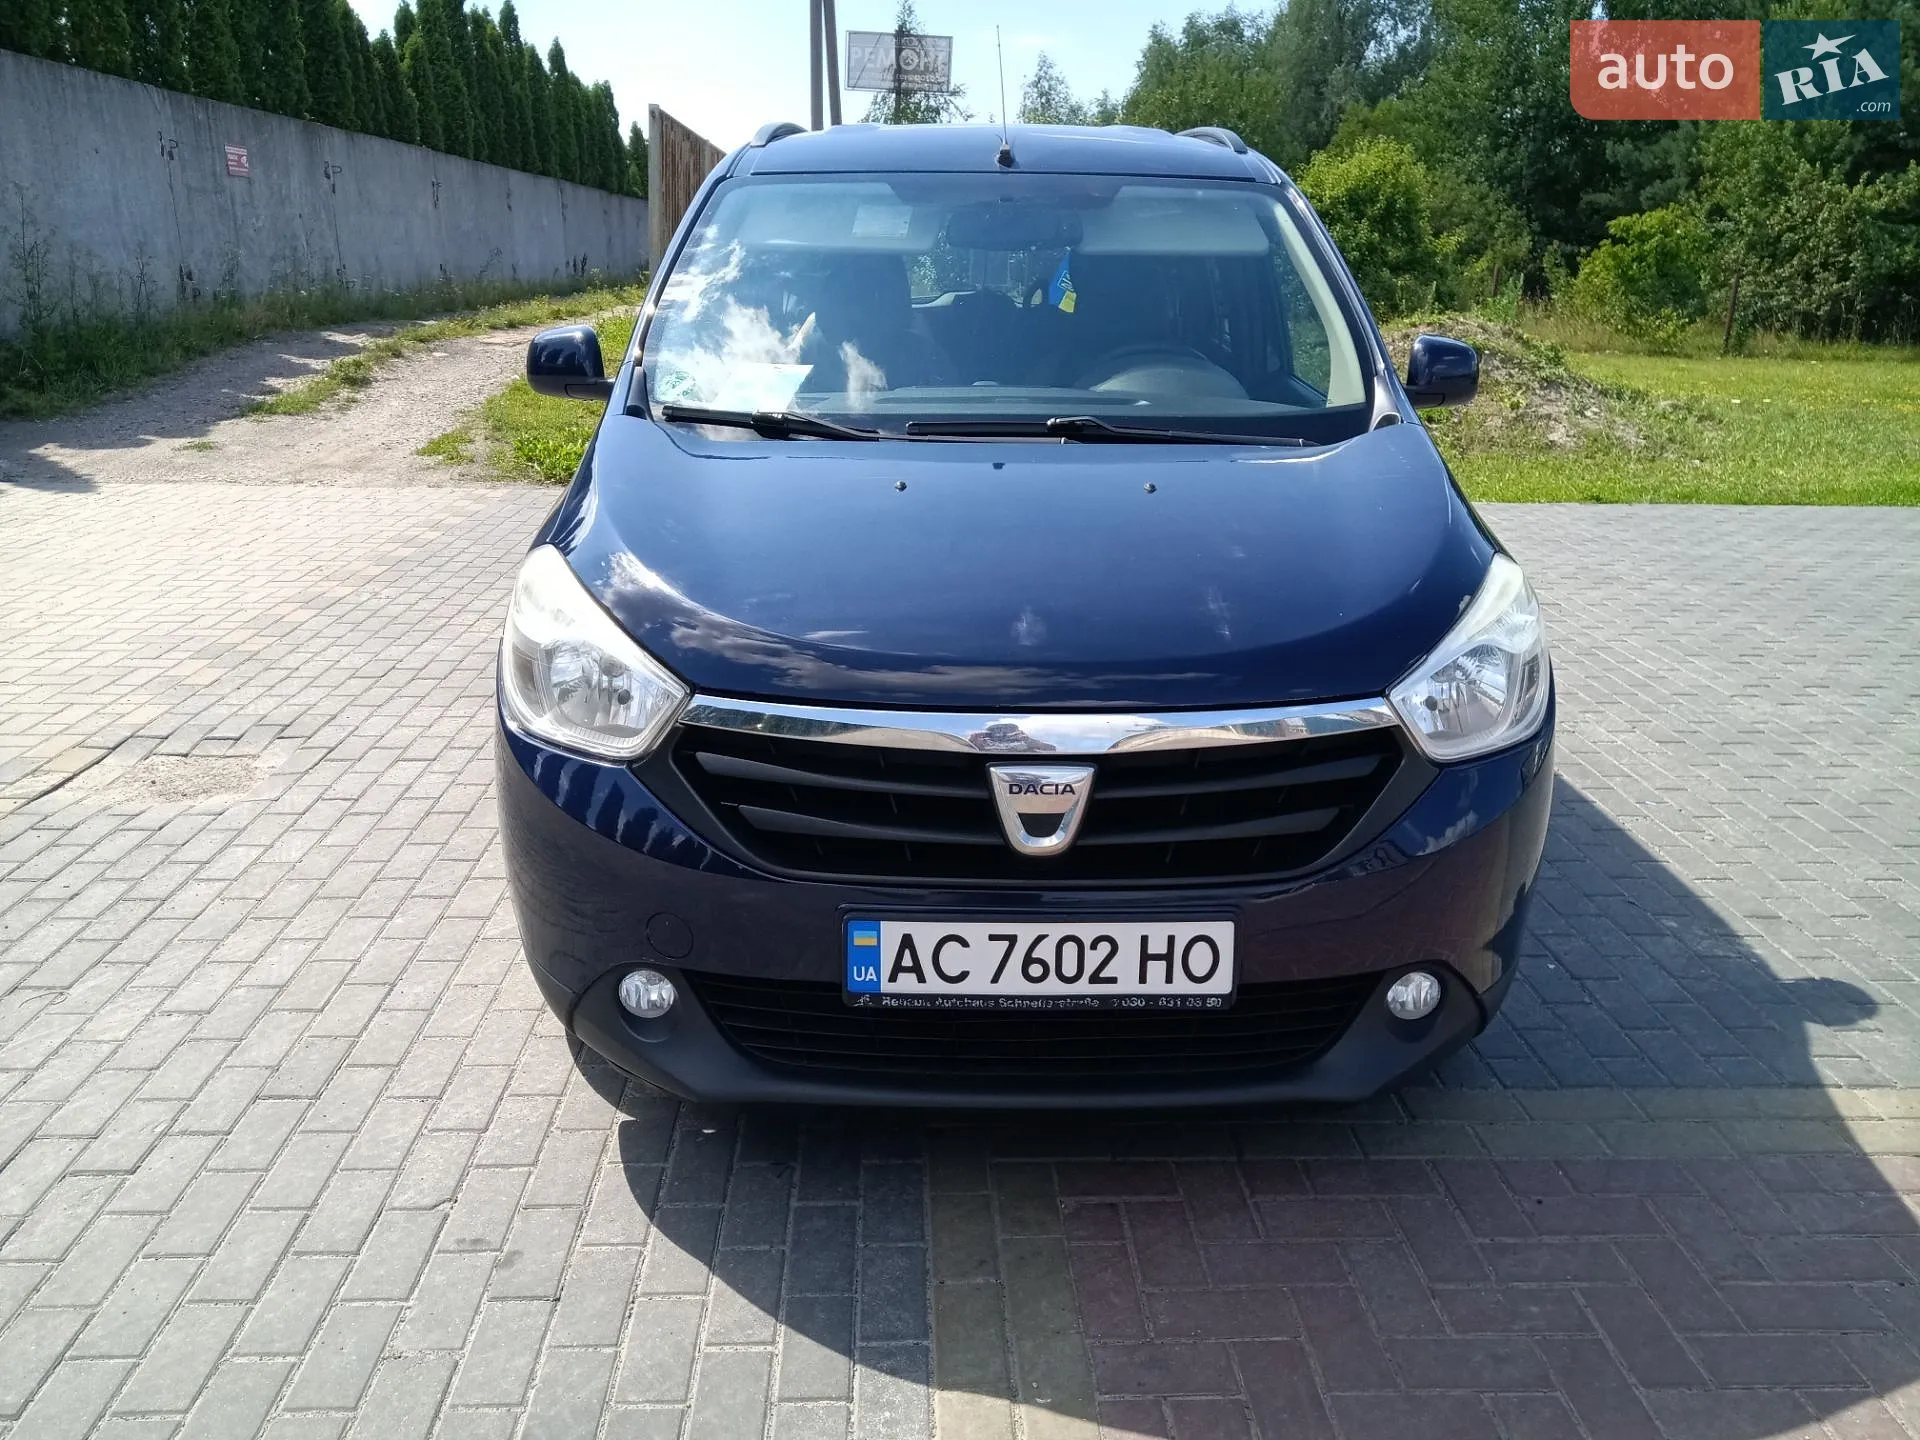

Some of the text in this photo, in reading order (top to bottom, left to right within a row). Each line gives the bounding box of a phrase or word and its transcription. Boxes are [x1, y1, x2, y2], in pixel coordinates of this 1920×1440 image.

[1008, 783, 1076, 796] DACIA
[887, 932, 1221, 985] AC 7602 HO
[852, 965, 878, 982] UA
